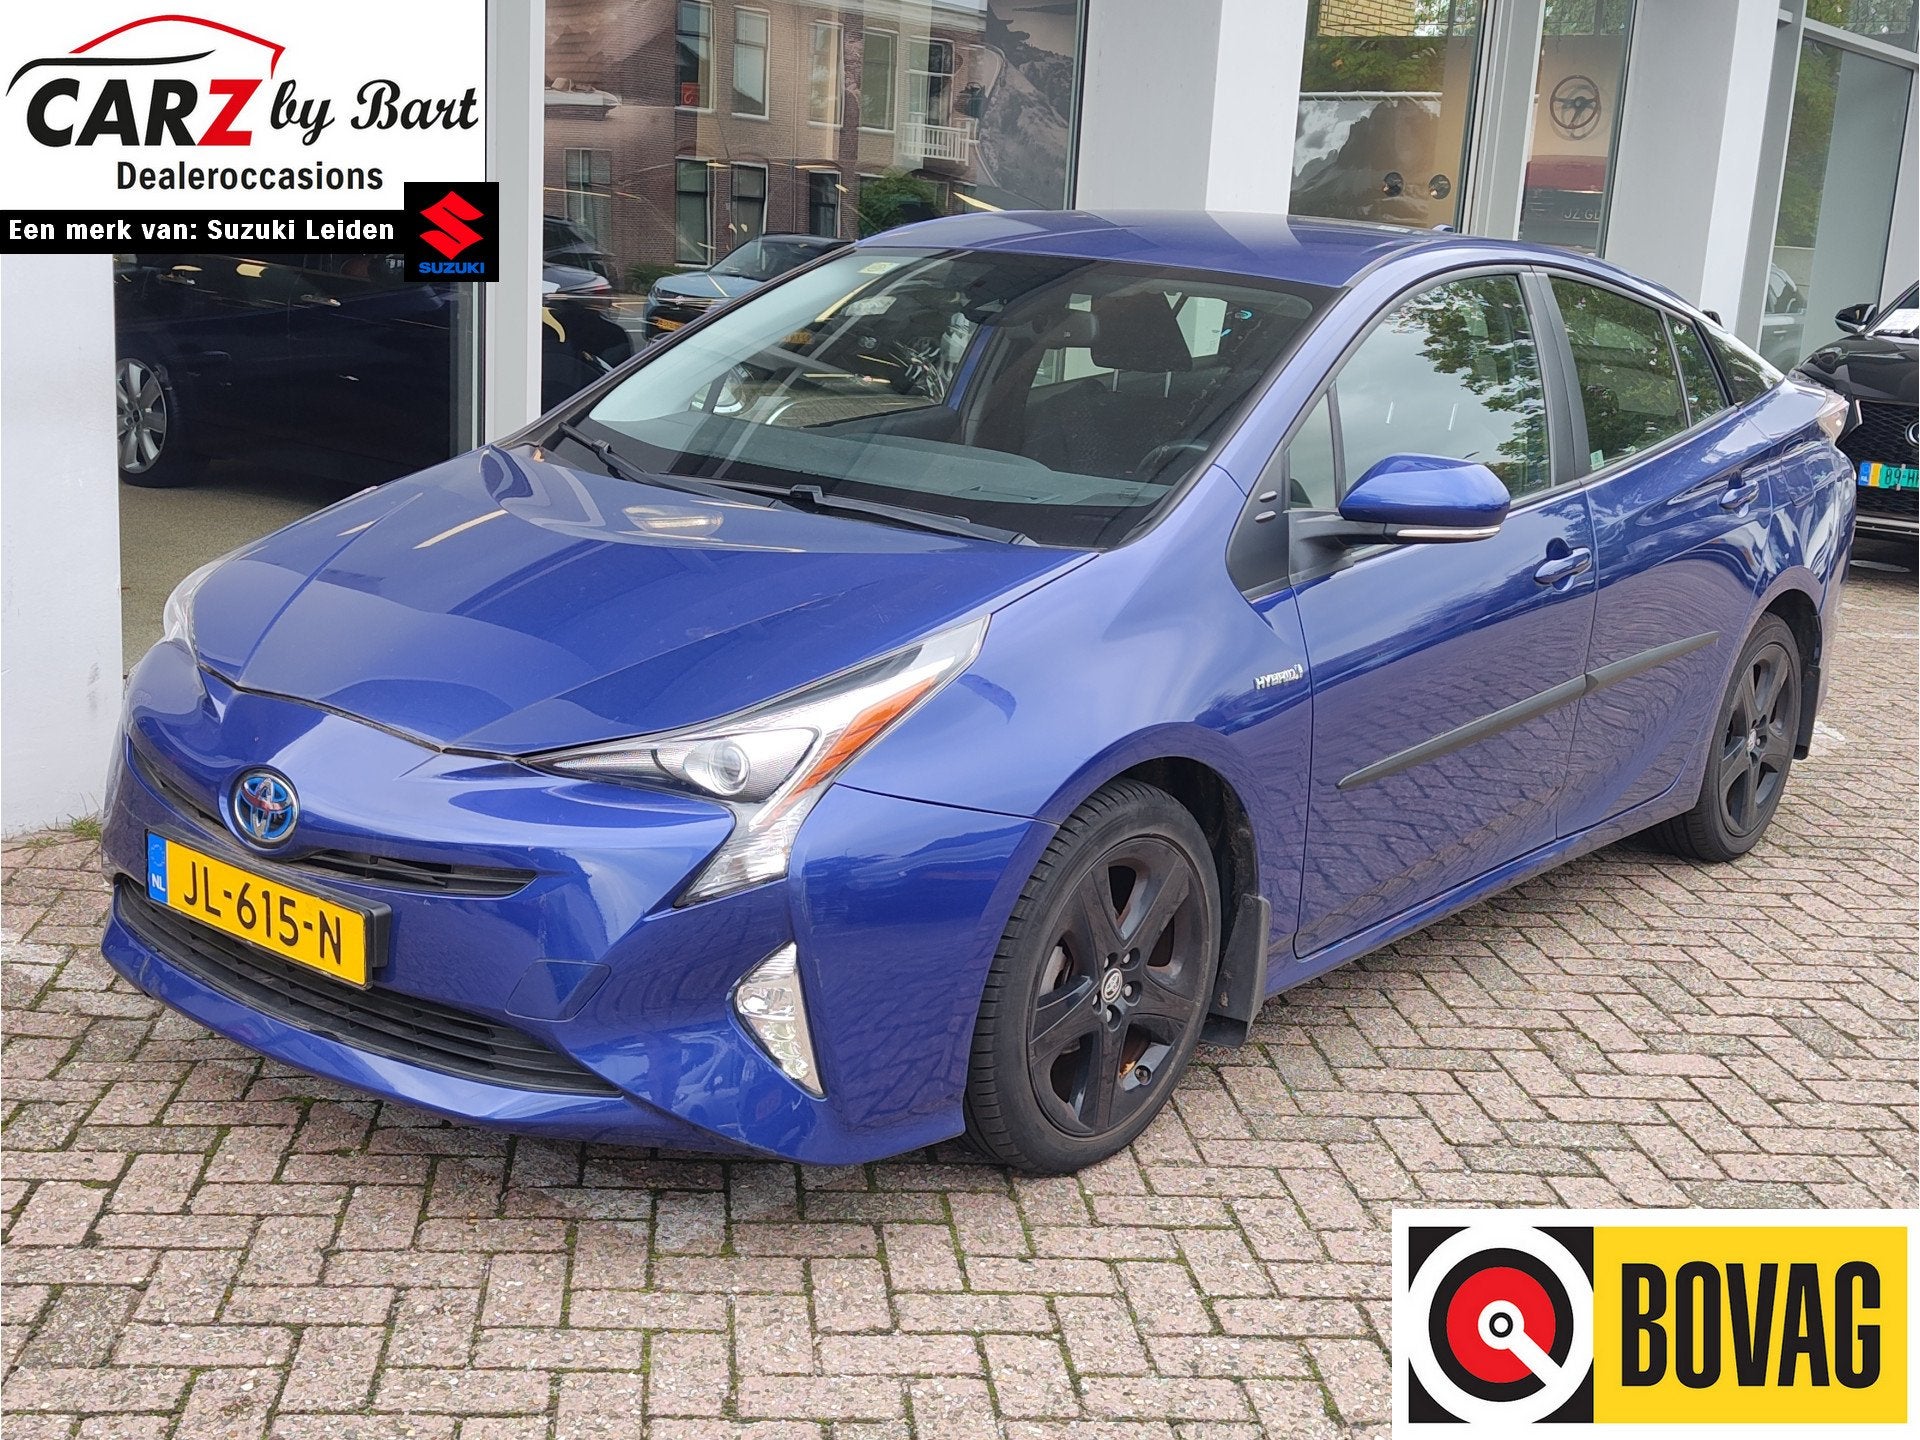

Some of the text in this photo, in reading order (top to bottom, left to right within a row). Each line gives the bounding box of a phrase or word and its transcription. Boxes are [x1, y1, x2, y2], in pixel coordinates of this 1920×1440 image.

[1254, 666, 1299, 690] HYBRID
[151, 872, 166, 892] NL
[184, 861, 342, 965] JL-615-N
